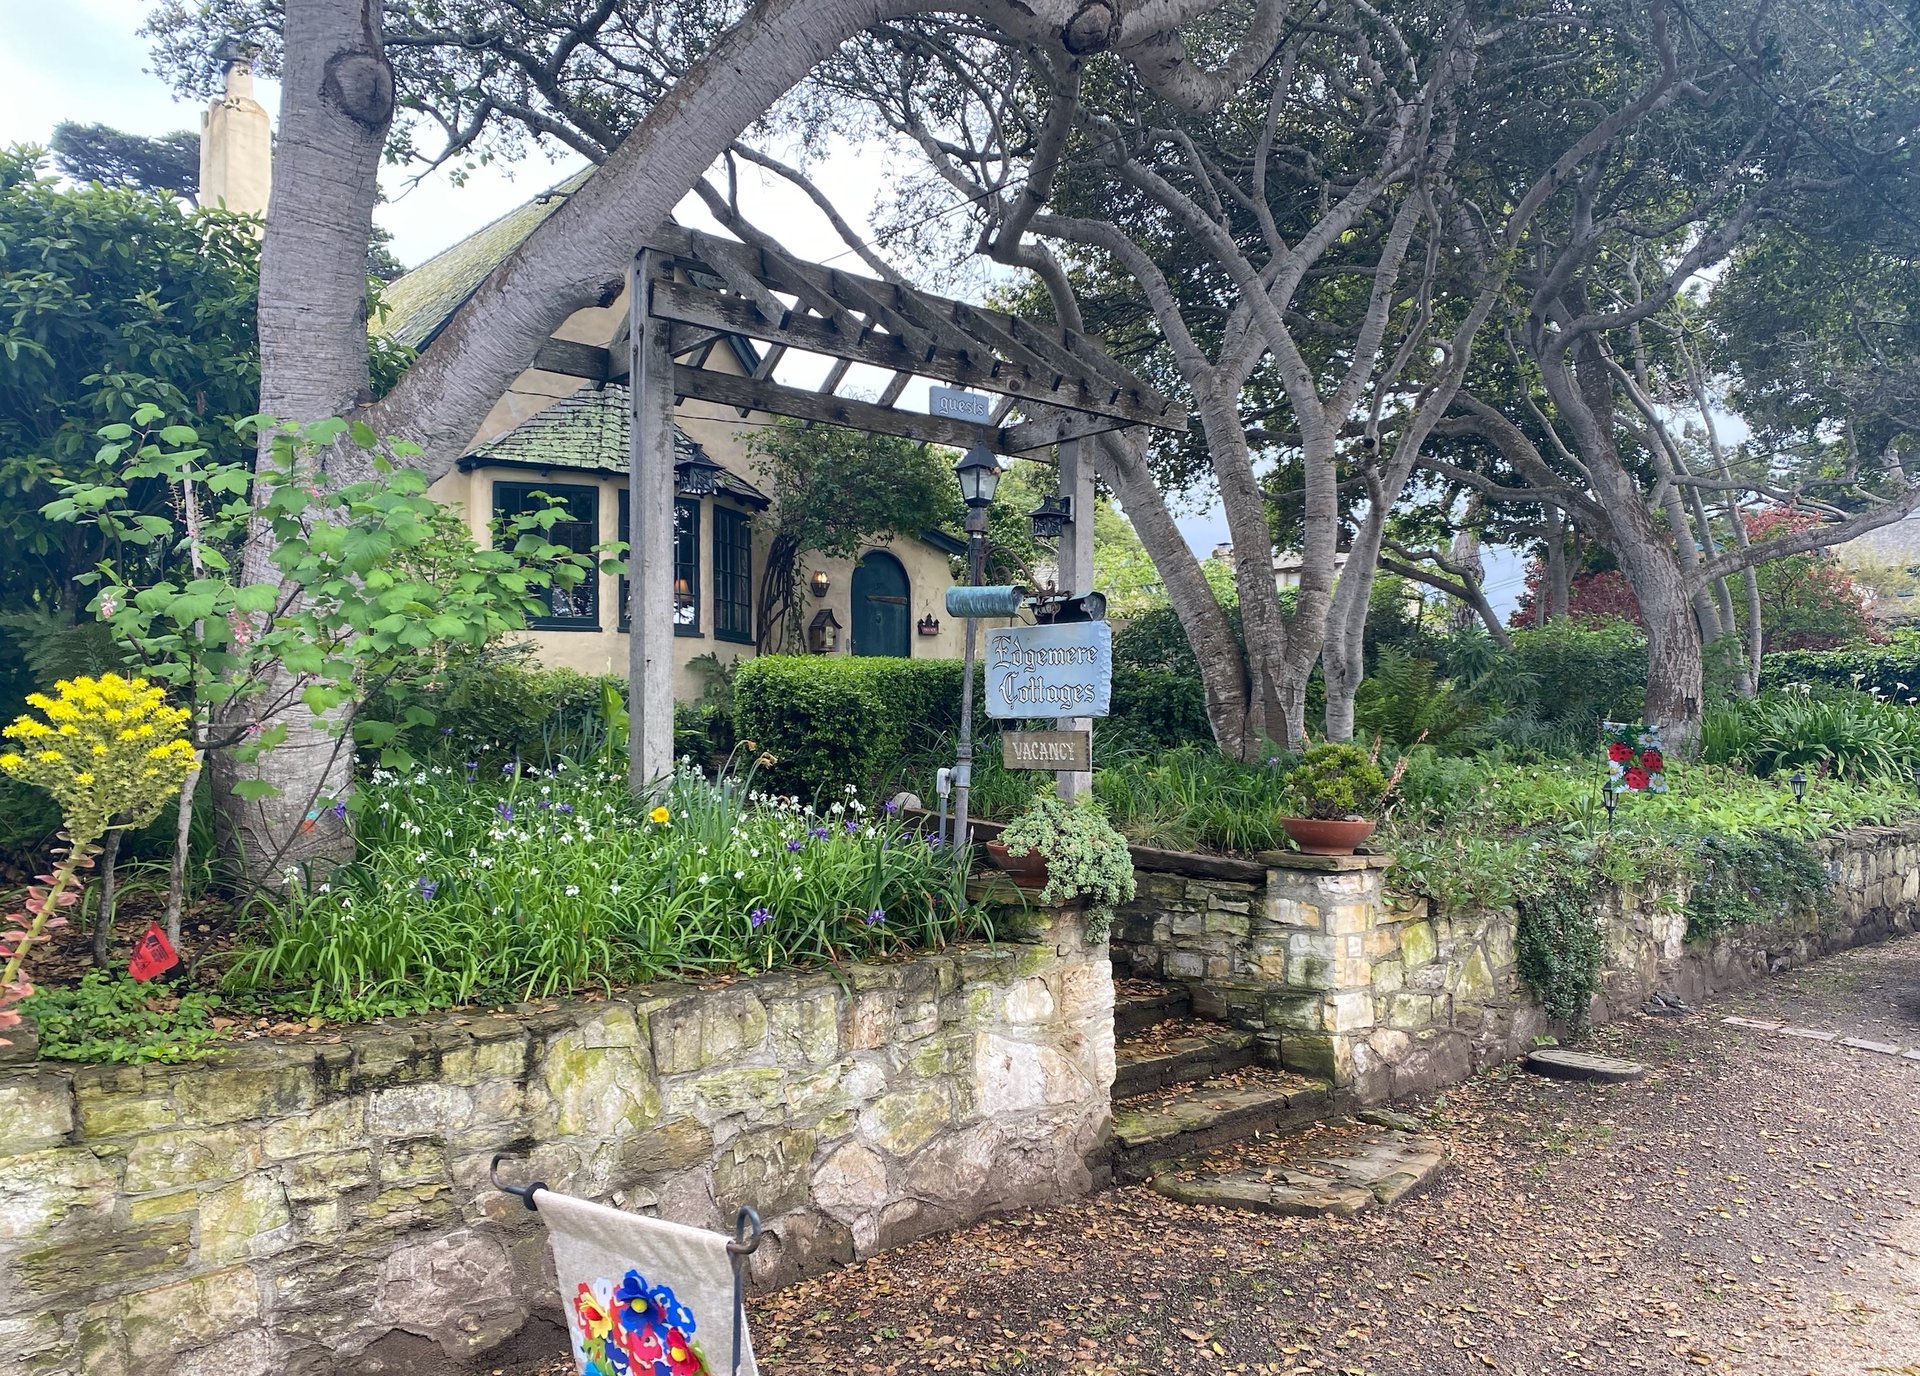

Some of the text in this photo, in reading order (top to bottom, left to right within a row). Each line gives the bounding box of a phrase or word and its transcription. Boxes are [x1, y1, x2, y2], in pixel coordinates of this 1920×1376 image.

[940, 395, 984, 416] guests
[992, 635, 1098, 673] Edgemere
[999, 671, 1095, 710] Cottages
[1012, 741, 1075, 761] VACANCY
